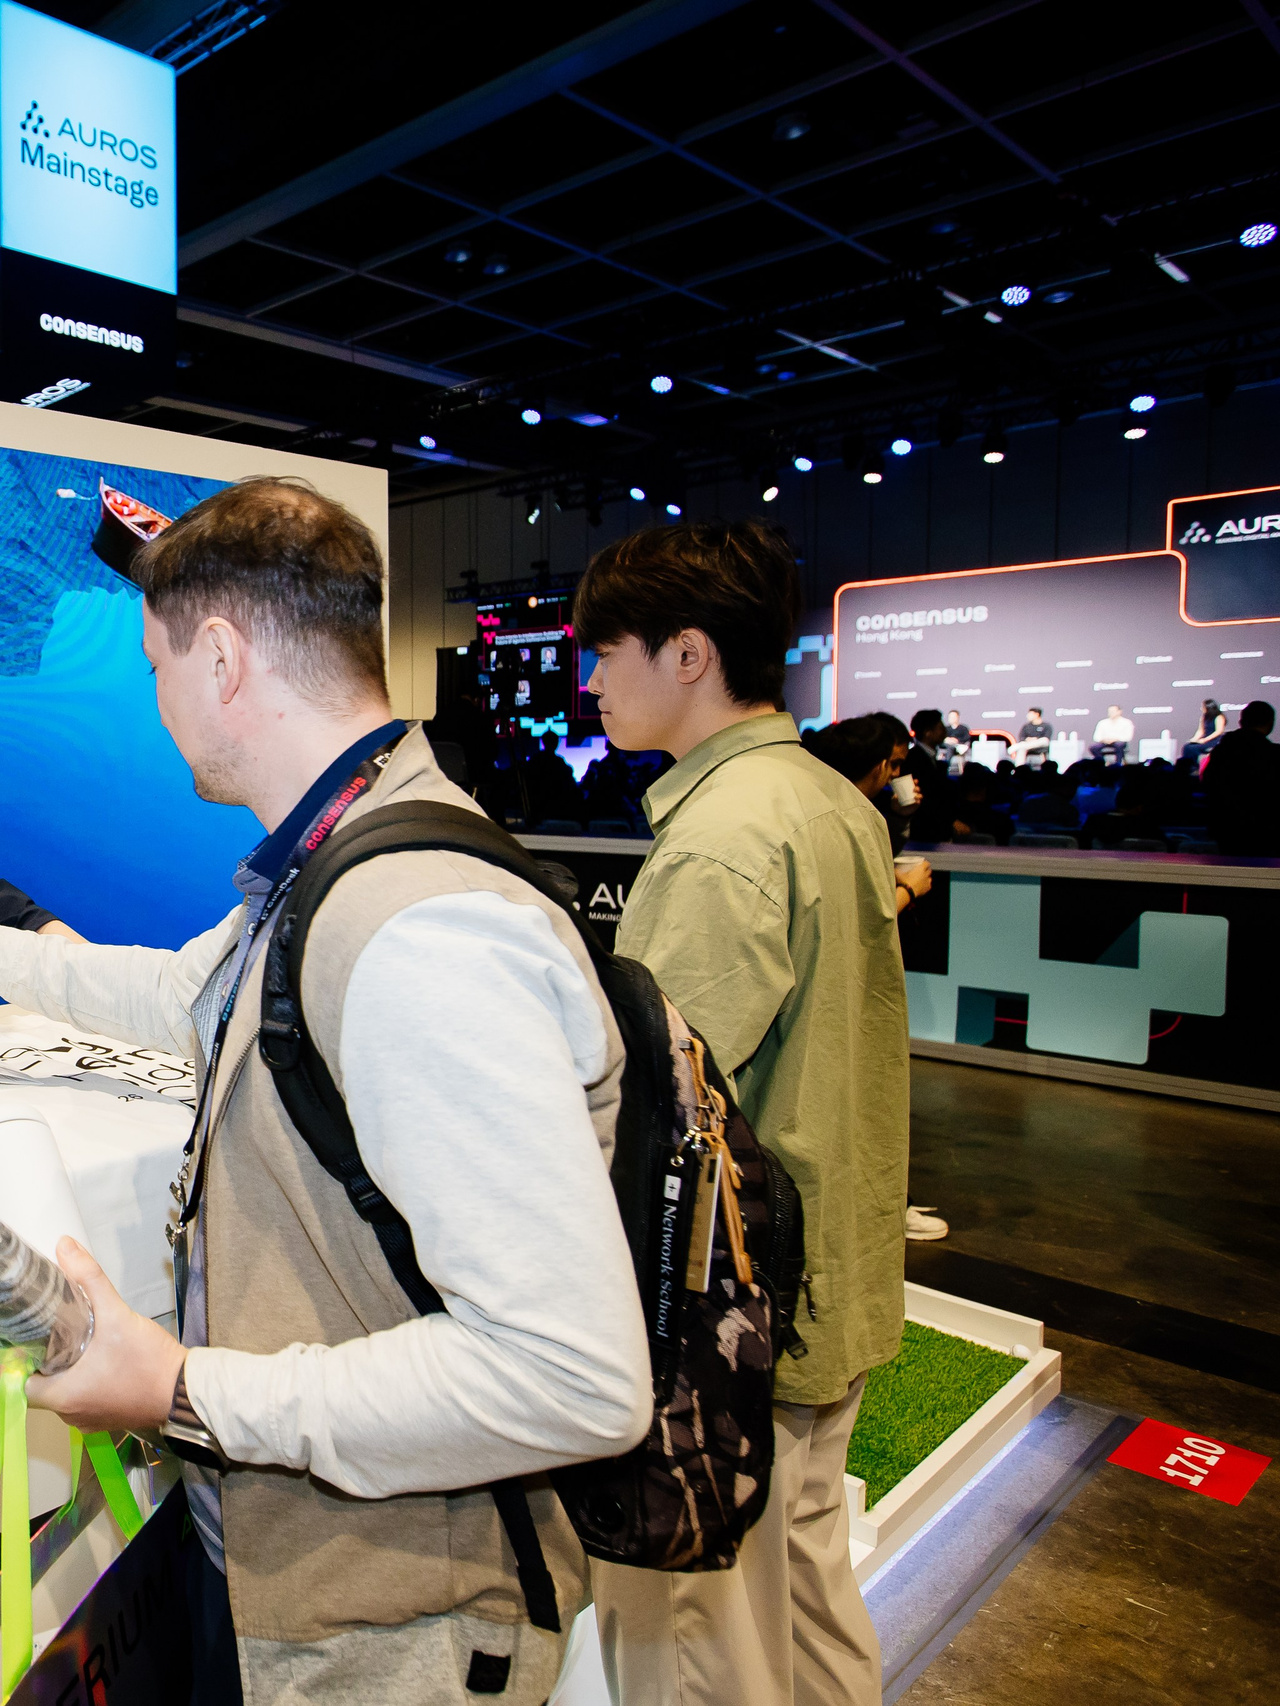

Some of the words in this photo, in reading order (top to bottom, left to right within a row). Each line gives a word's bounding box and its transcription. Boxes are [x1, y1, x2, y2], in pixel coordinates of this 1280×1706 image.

[20, 137, 159, 209] Mainstage
[58, 117, 158, 170] AUROS
[658, 1203, 677, 1276] Network
[656, 1277, 674, 1338] School
[1159, 1437, 1226, 1487] 1710
